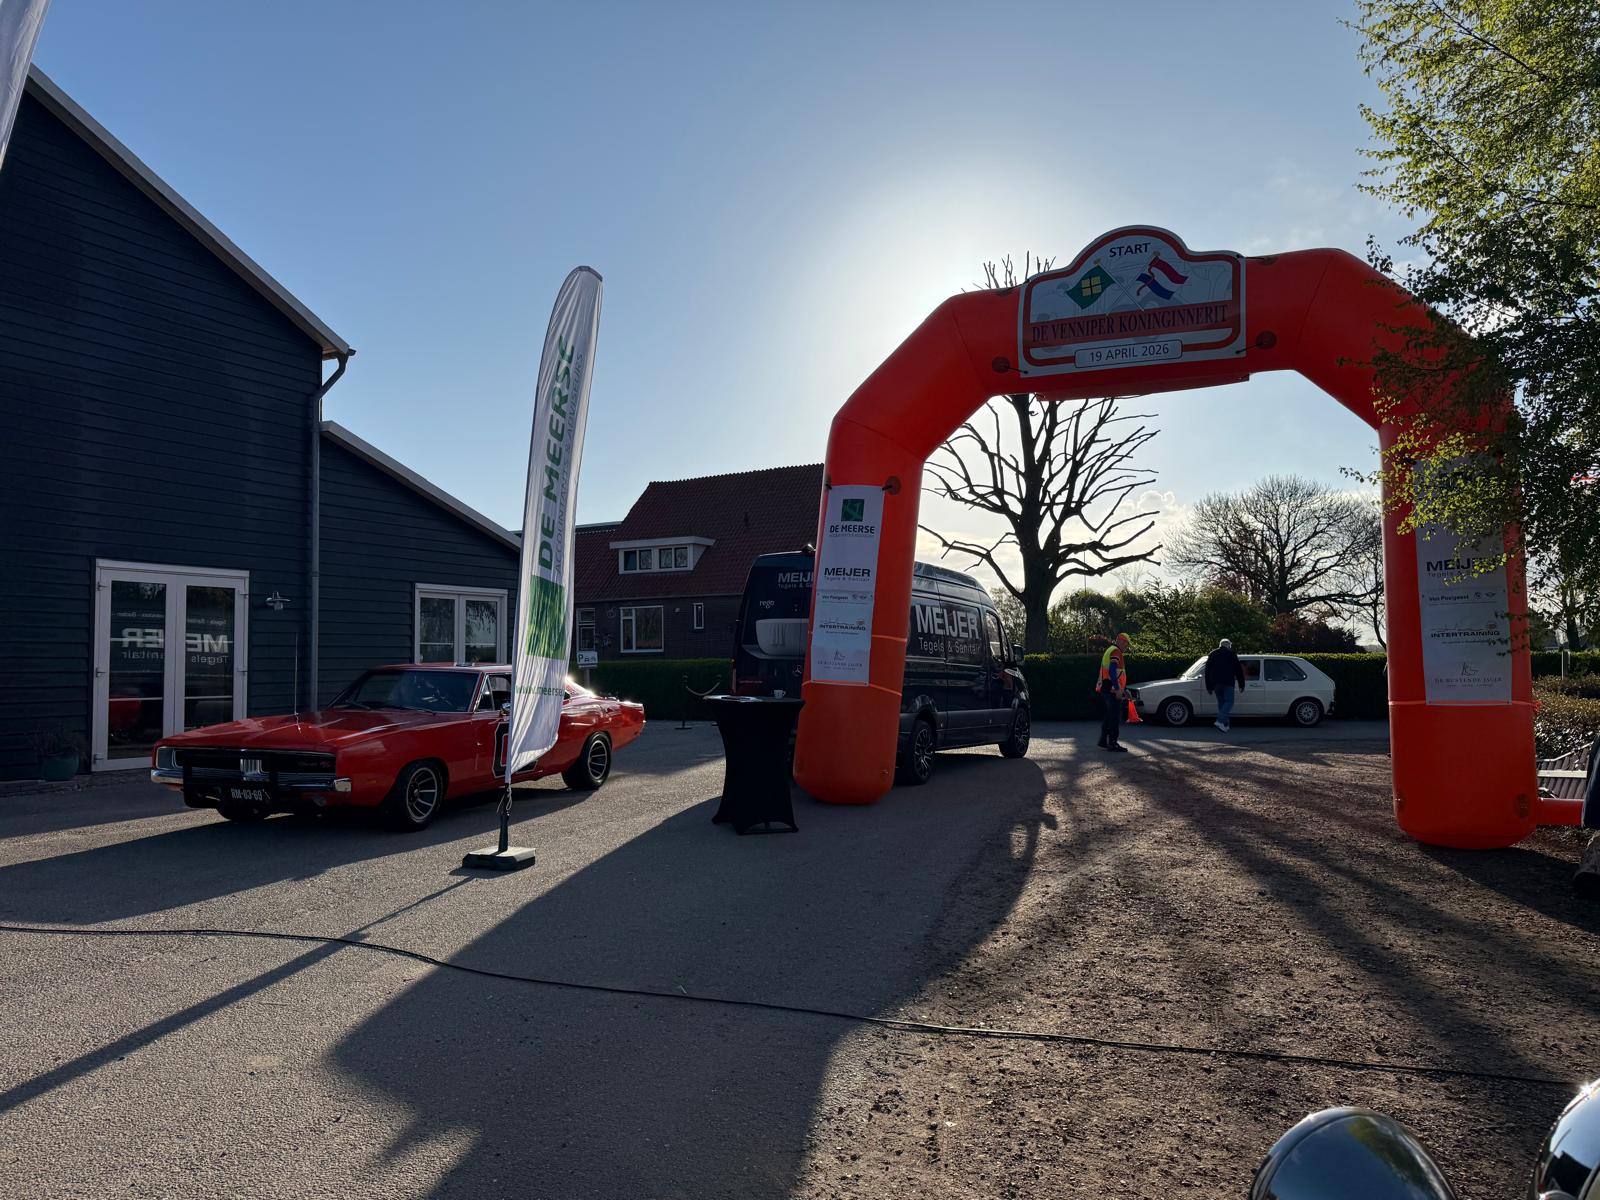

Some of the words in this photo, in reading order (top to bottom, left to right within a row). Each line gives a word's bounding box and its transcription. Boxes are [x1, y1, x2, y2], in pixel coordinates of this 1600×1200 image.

[1109, 242, 1151, 258] START
[1032, 325, 1049, 342] DE
[1050, 316, 1115, 340] VENNIPER
[1119, 304, 1229, 333] KONINGINNERIT
[1090, 351, 1102, 363] 19
[1105, 347, 1138, 361] APRIL
[1142, 345, 1169, 358] 2026
[544, 335, 575, 504] MEERSE
[554, 461, 570, 574] ACCOUNTANTS
[566, 353, 583, 439] ADVISEURS
[829, 524, 840, 533] DE
[841, 524, 876, 534] MEERSE
[538, 512, 555, 570] DE
[824, 567, 871, 577] MEIJER
[915, 604, 980, 640] MEIJER
[1431, 630, 1500, 638] INTERTRAINING
[918, 637, 945, 654] Tegels
[947, 641, 954, 653] &
[954, 641, 982, 656] Sanitair
